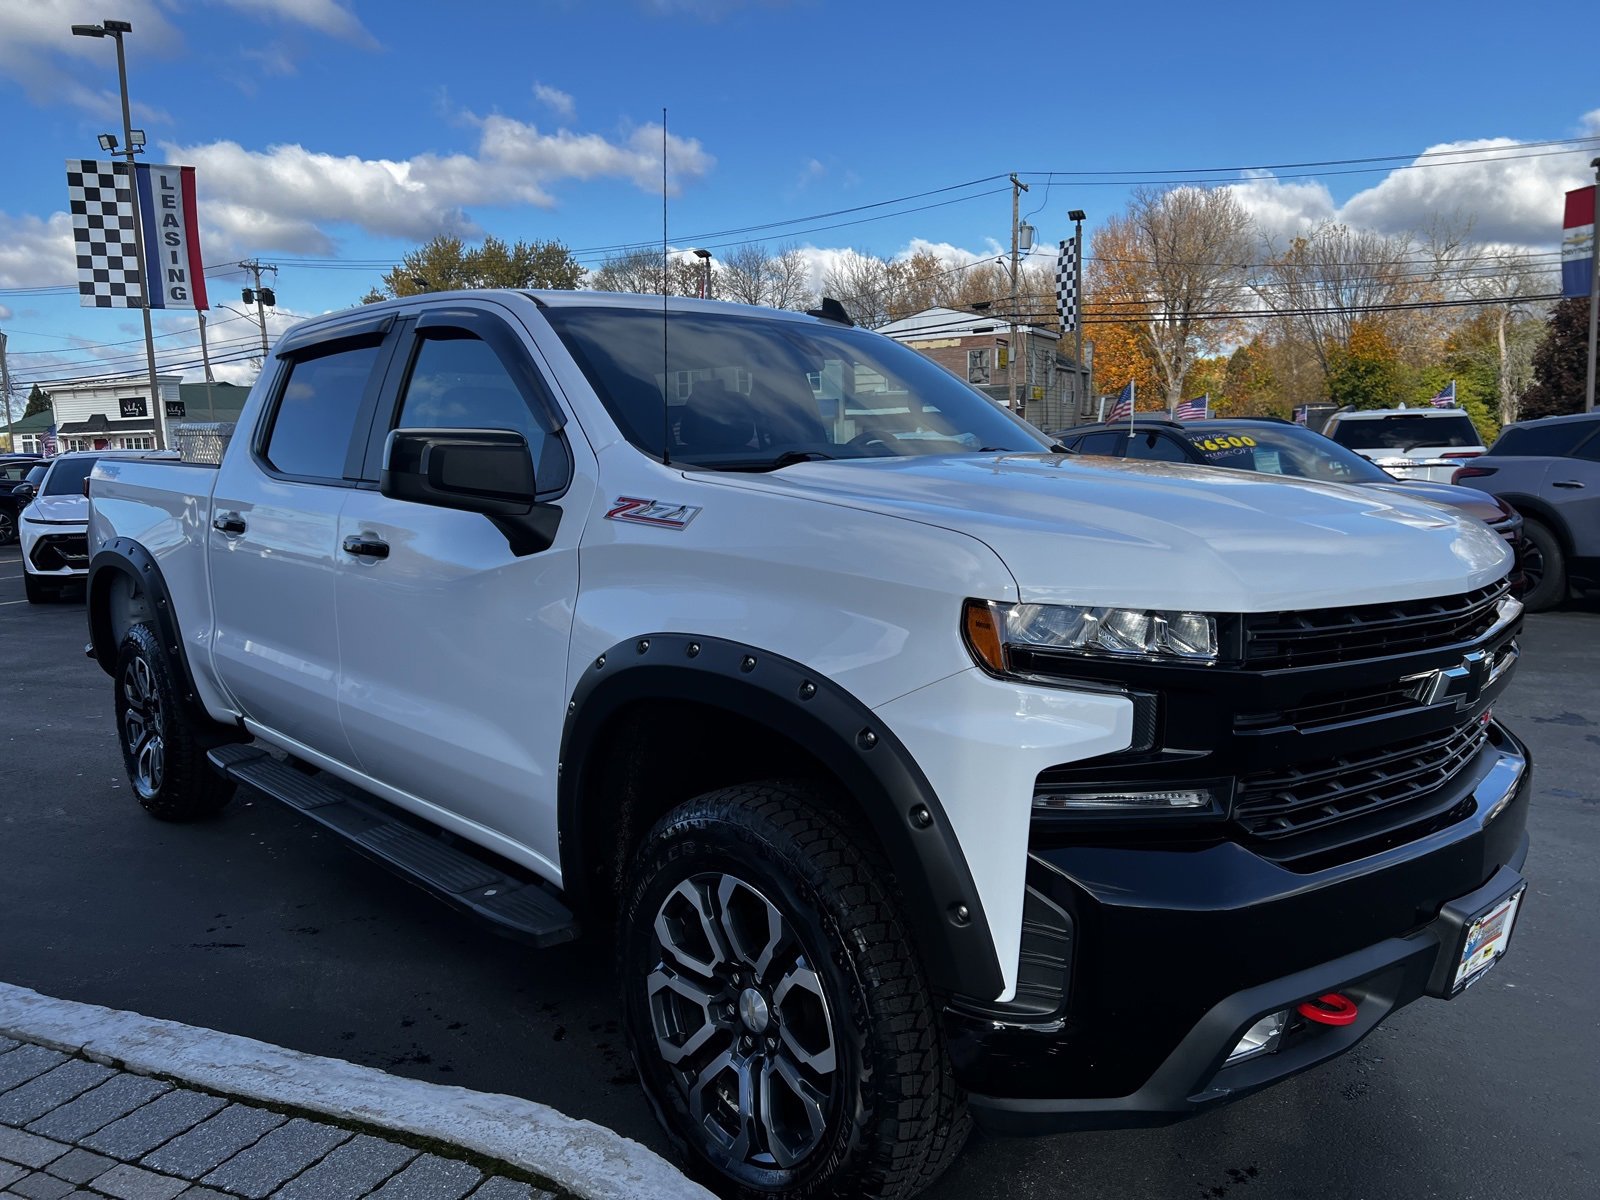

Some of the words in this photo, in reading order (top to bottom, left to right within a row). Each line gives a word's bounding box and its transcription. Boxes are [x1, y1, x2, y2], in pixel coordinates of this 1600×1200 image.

[160, 175, 187, 301] LEASING
[1193, 436, 1257, 451] $6500
[603, 495, 703, 531] Z71
